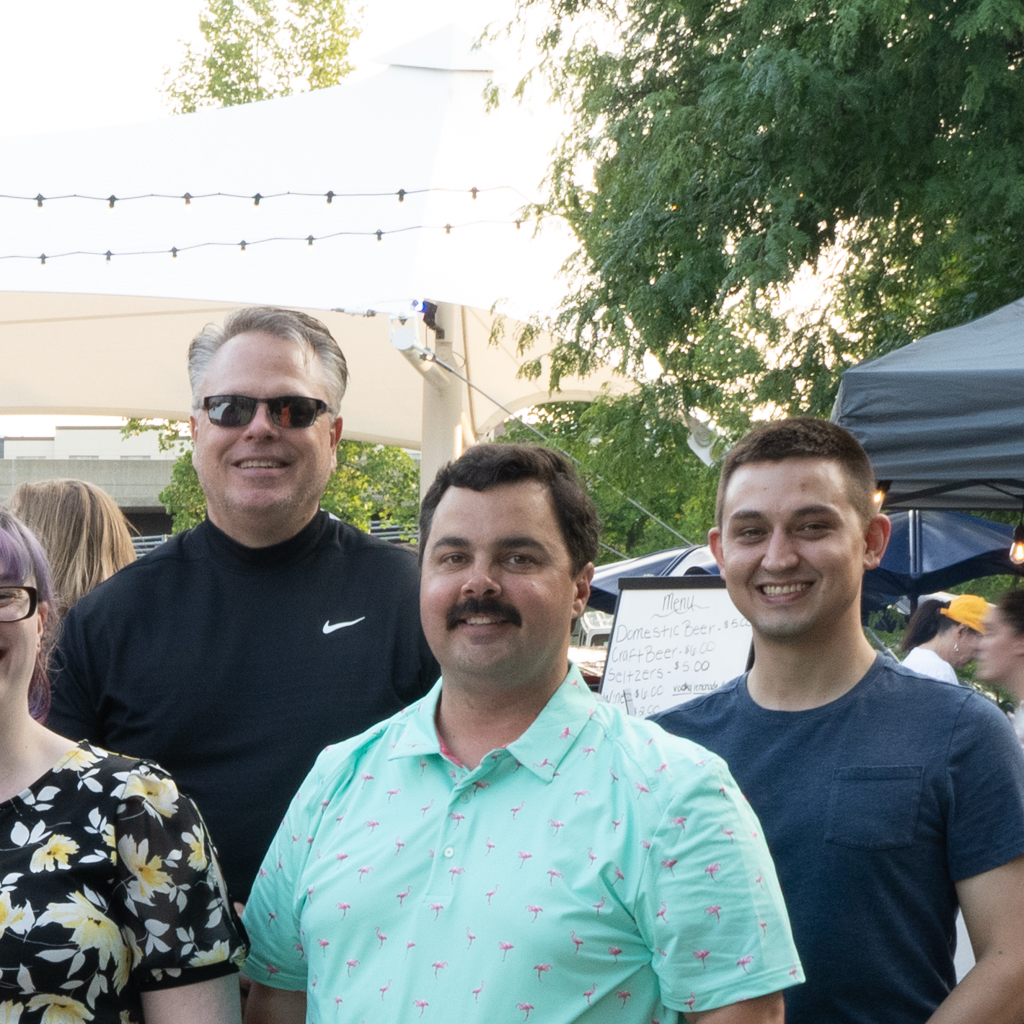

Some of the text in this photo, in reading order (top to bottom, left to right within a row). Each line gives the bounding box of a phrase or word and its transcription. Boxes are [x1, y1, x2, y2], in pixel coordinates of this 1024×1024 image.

[662, 592, 699, 612] Menu
[681, 619, 716, 638] Beer
[611, 645, 644, 663] Craft
[644, 644, 678, 663] Beer
[607, 667, 664, 684] Seltzers
